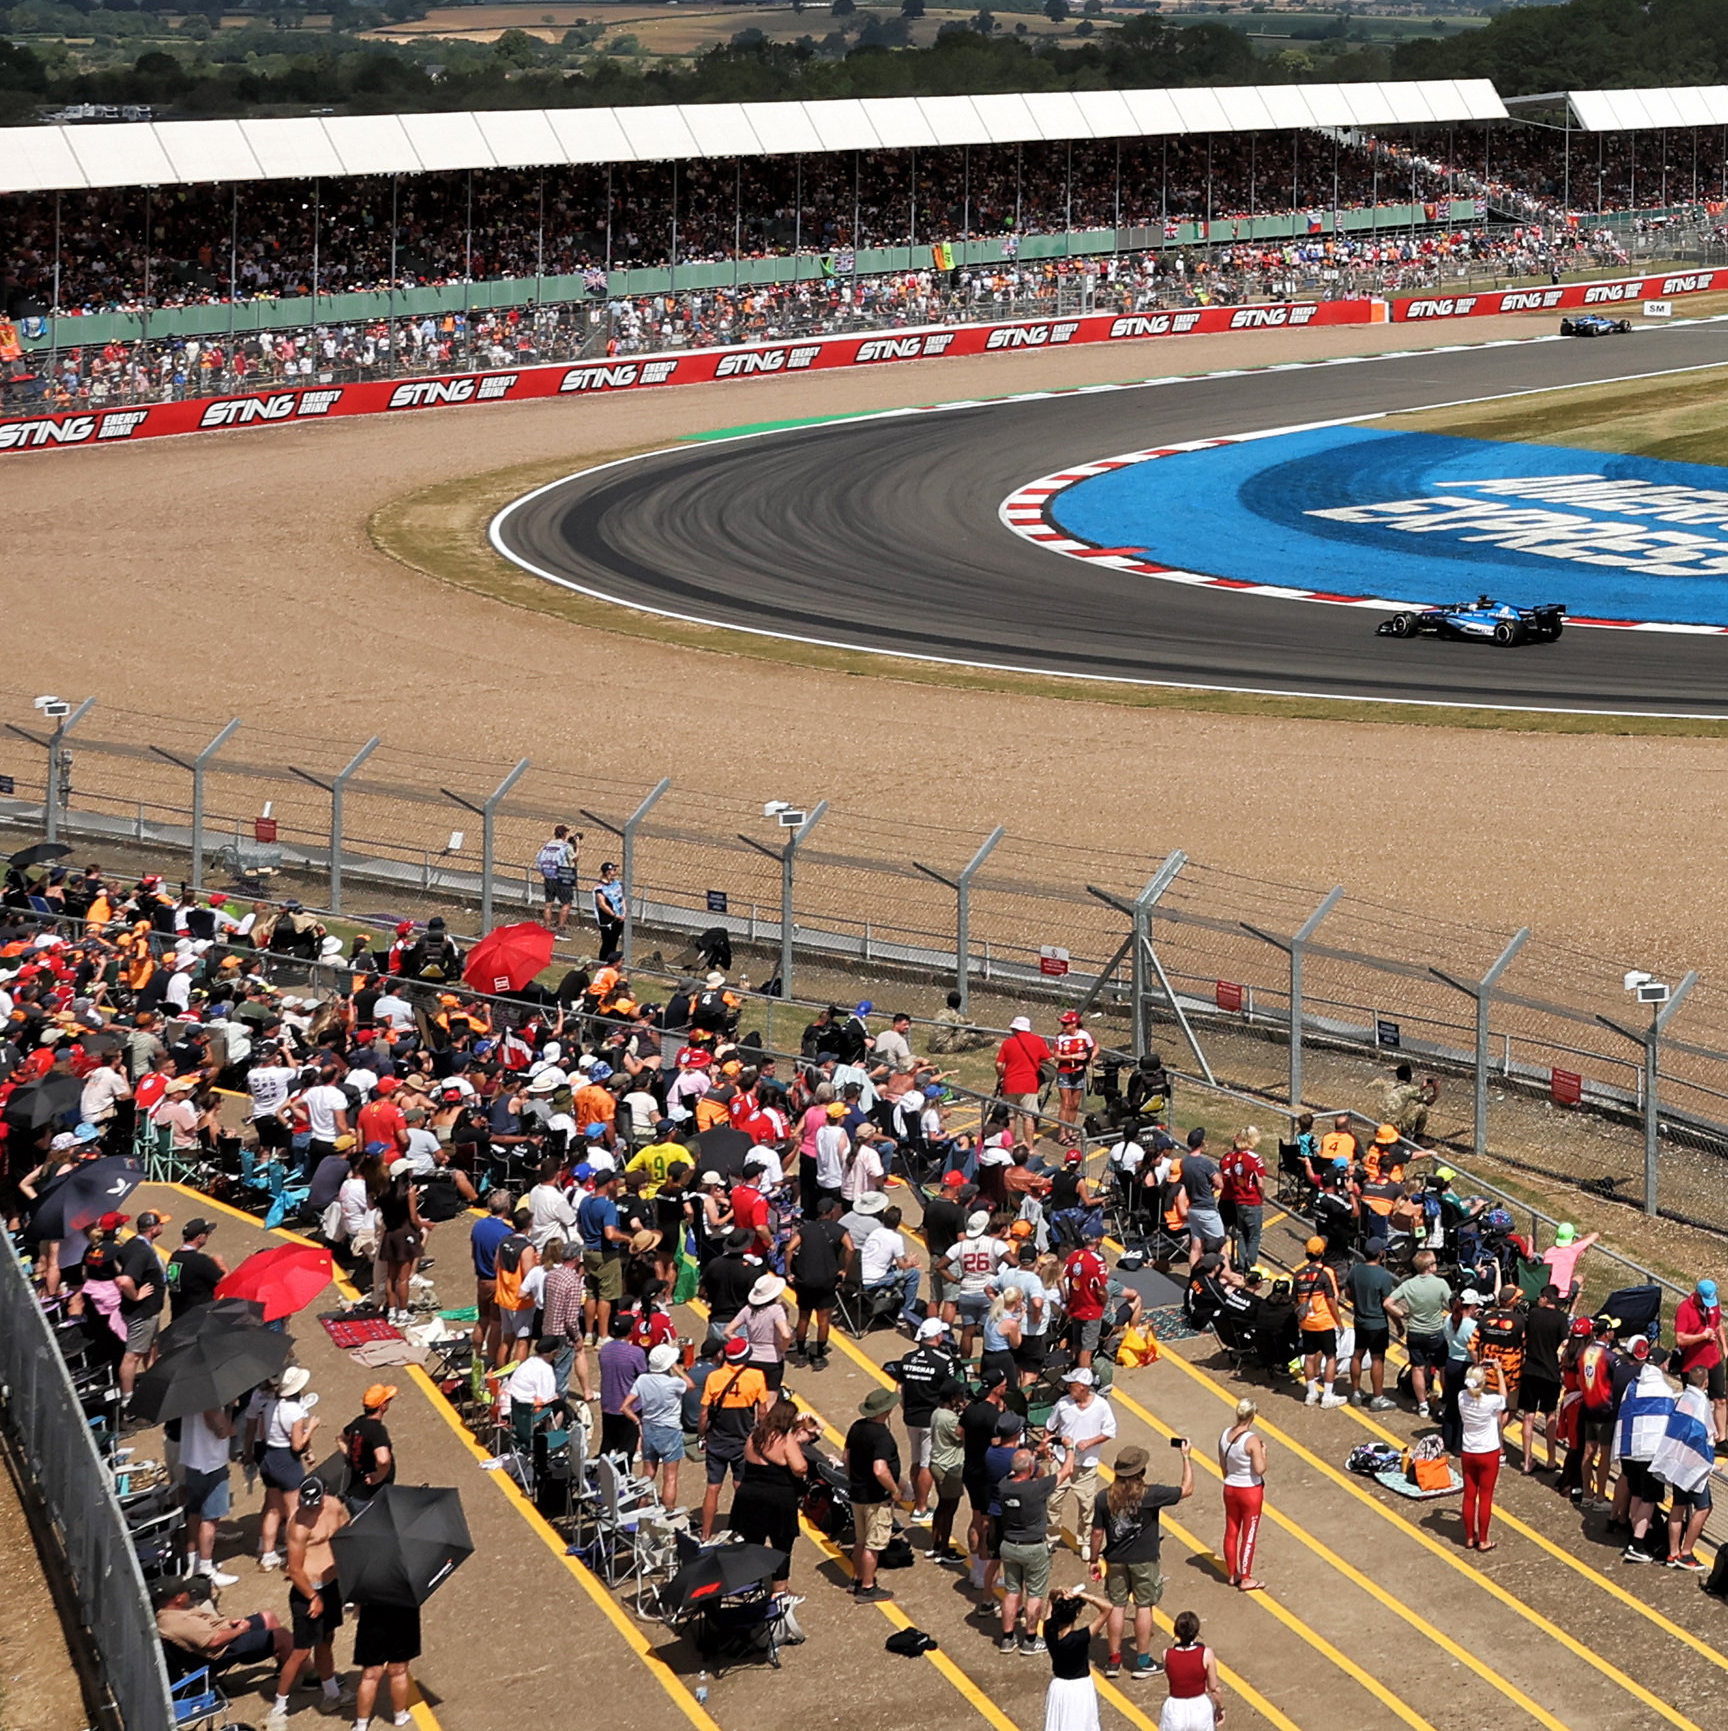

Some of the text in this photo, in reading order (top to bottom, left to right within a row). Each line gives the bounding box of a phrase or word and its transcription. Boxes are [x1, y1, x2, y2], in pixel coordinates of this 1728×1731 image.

[1584, 284, 1624, 304] STING
[1662, 275, 1697, 295] STING
[1407, 298, 1454, 318] STING
[1500, 292, 1542, 311] STING
[1649, 304, 1666, 313] SM
[1110, 315, 1170, 337] STING
[1231, 307, 1288, 329] STING
[986, 326, 1048, 349] STING
[855, 337, 921, 362] STING
[643, 360, 679, 374] ENERGY
[715, 349, 785, 377] STING
[481, 375, 518, 390] ENERGY
[560, 364, 638, 392] STING
[301, 389, 343, 404] ENERGY
[389, 378, 475, 407] STING
[200, 395, 295, 427] STING
[298, 400, 330, 415] DRINK
[102, 411, 148, 428] ENERGY
[0, 417, 94, 448] STING
[98, 423, 133, 439] DRINK
[702, 994, 711, 1005] 4
[1328, 1141, 1339, 1152] 4
[654, 1155, 665, 1180] 9
[963, 1252, 989, 1271] 26
[727, 1382, 741, 1398] 4
